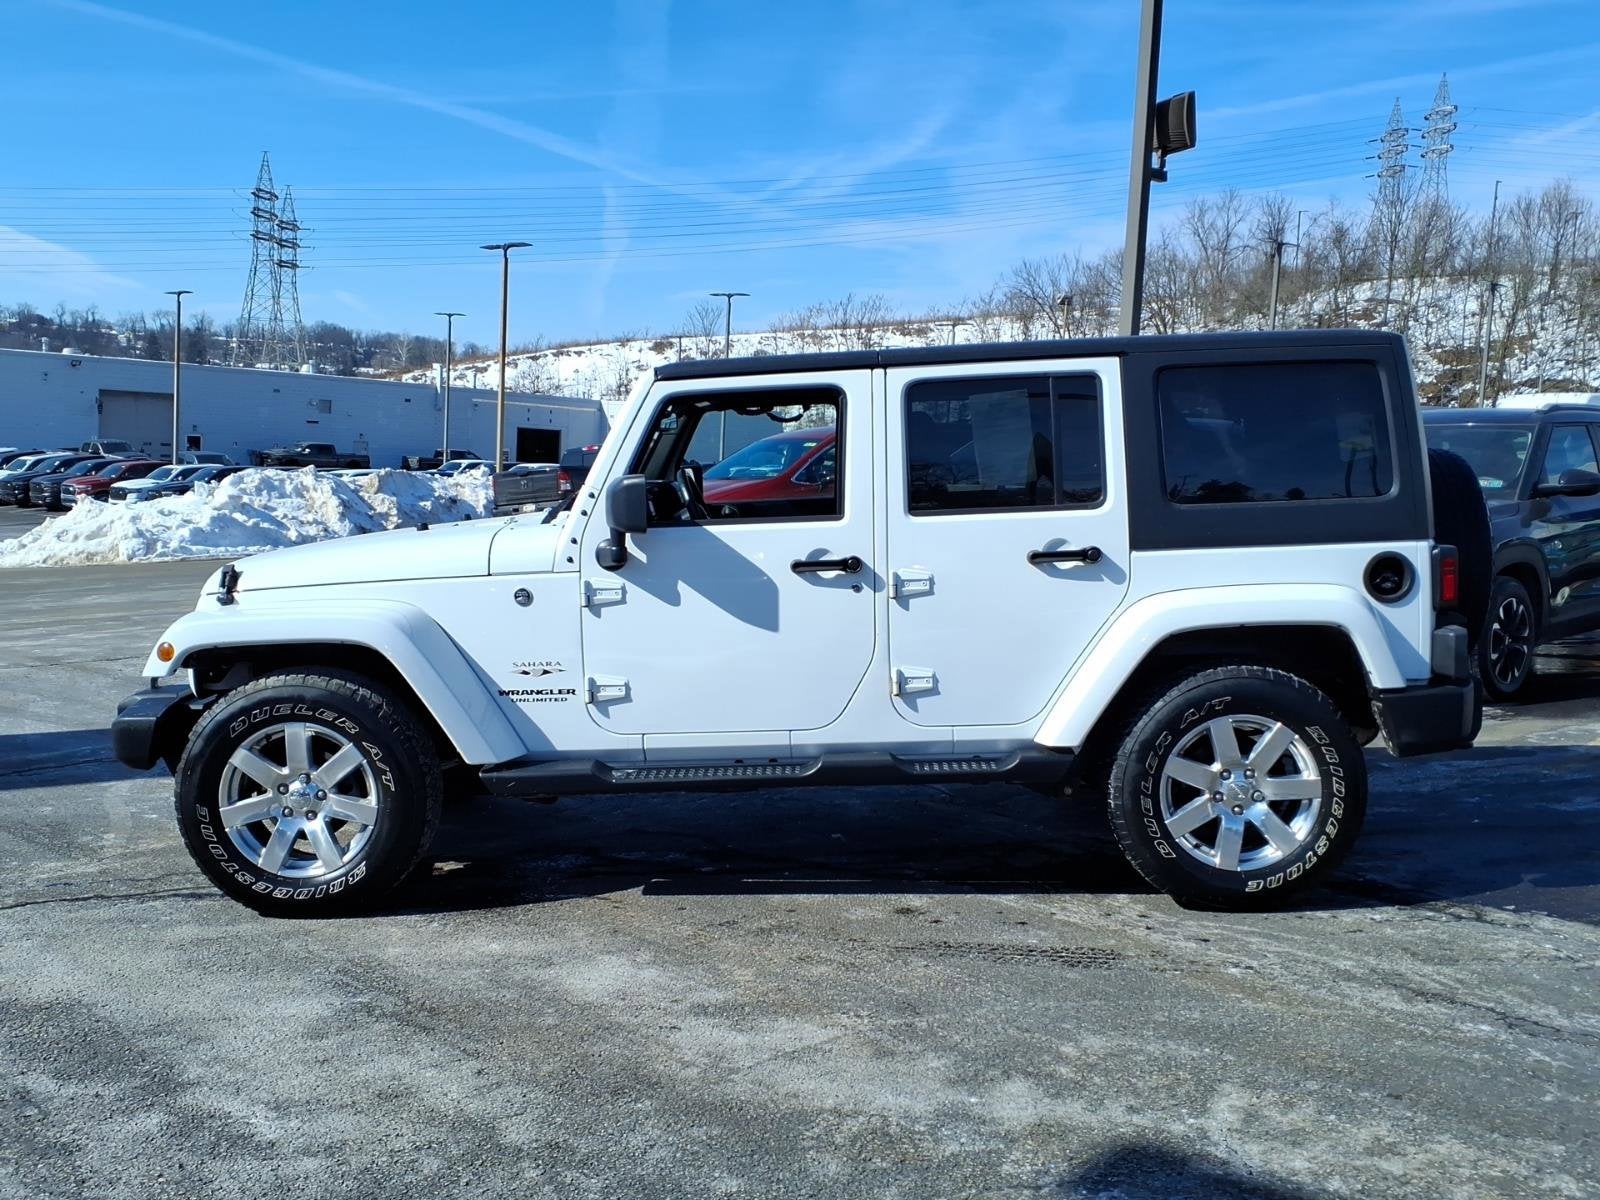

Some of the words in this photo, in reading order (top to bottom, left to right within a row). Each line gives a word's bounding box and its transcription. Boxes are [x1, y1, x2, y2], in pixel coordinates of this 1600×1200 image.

[498, 688, 576, 697] WRANGLER
[229, 703, 360, 738] DUELER
[361, 740, 396, 792] A/T
[1140, 730, 1176, 859] DUELER
[1180, 696, 1232, 729] A/T
[195, 803, 367, 900] BRIDGESTONE
[1245, 725, 1346, 893] BRIDGESTONE
